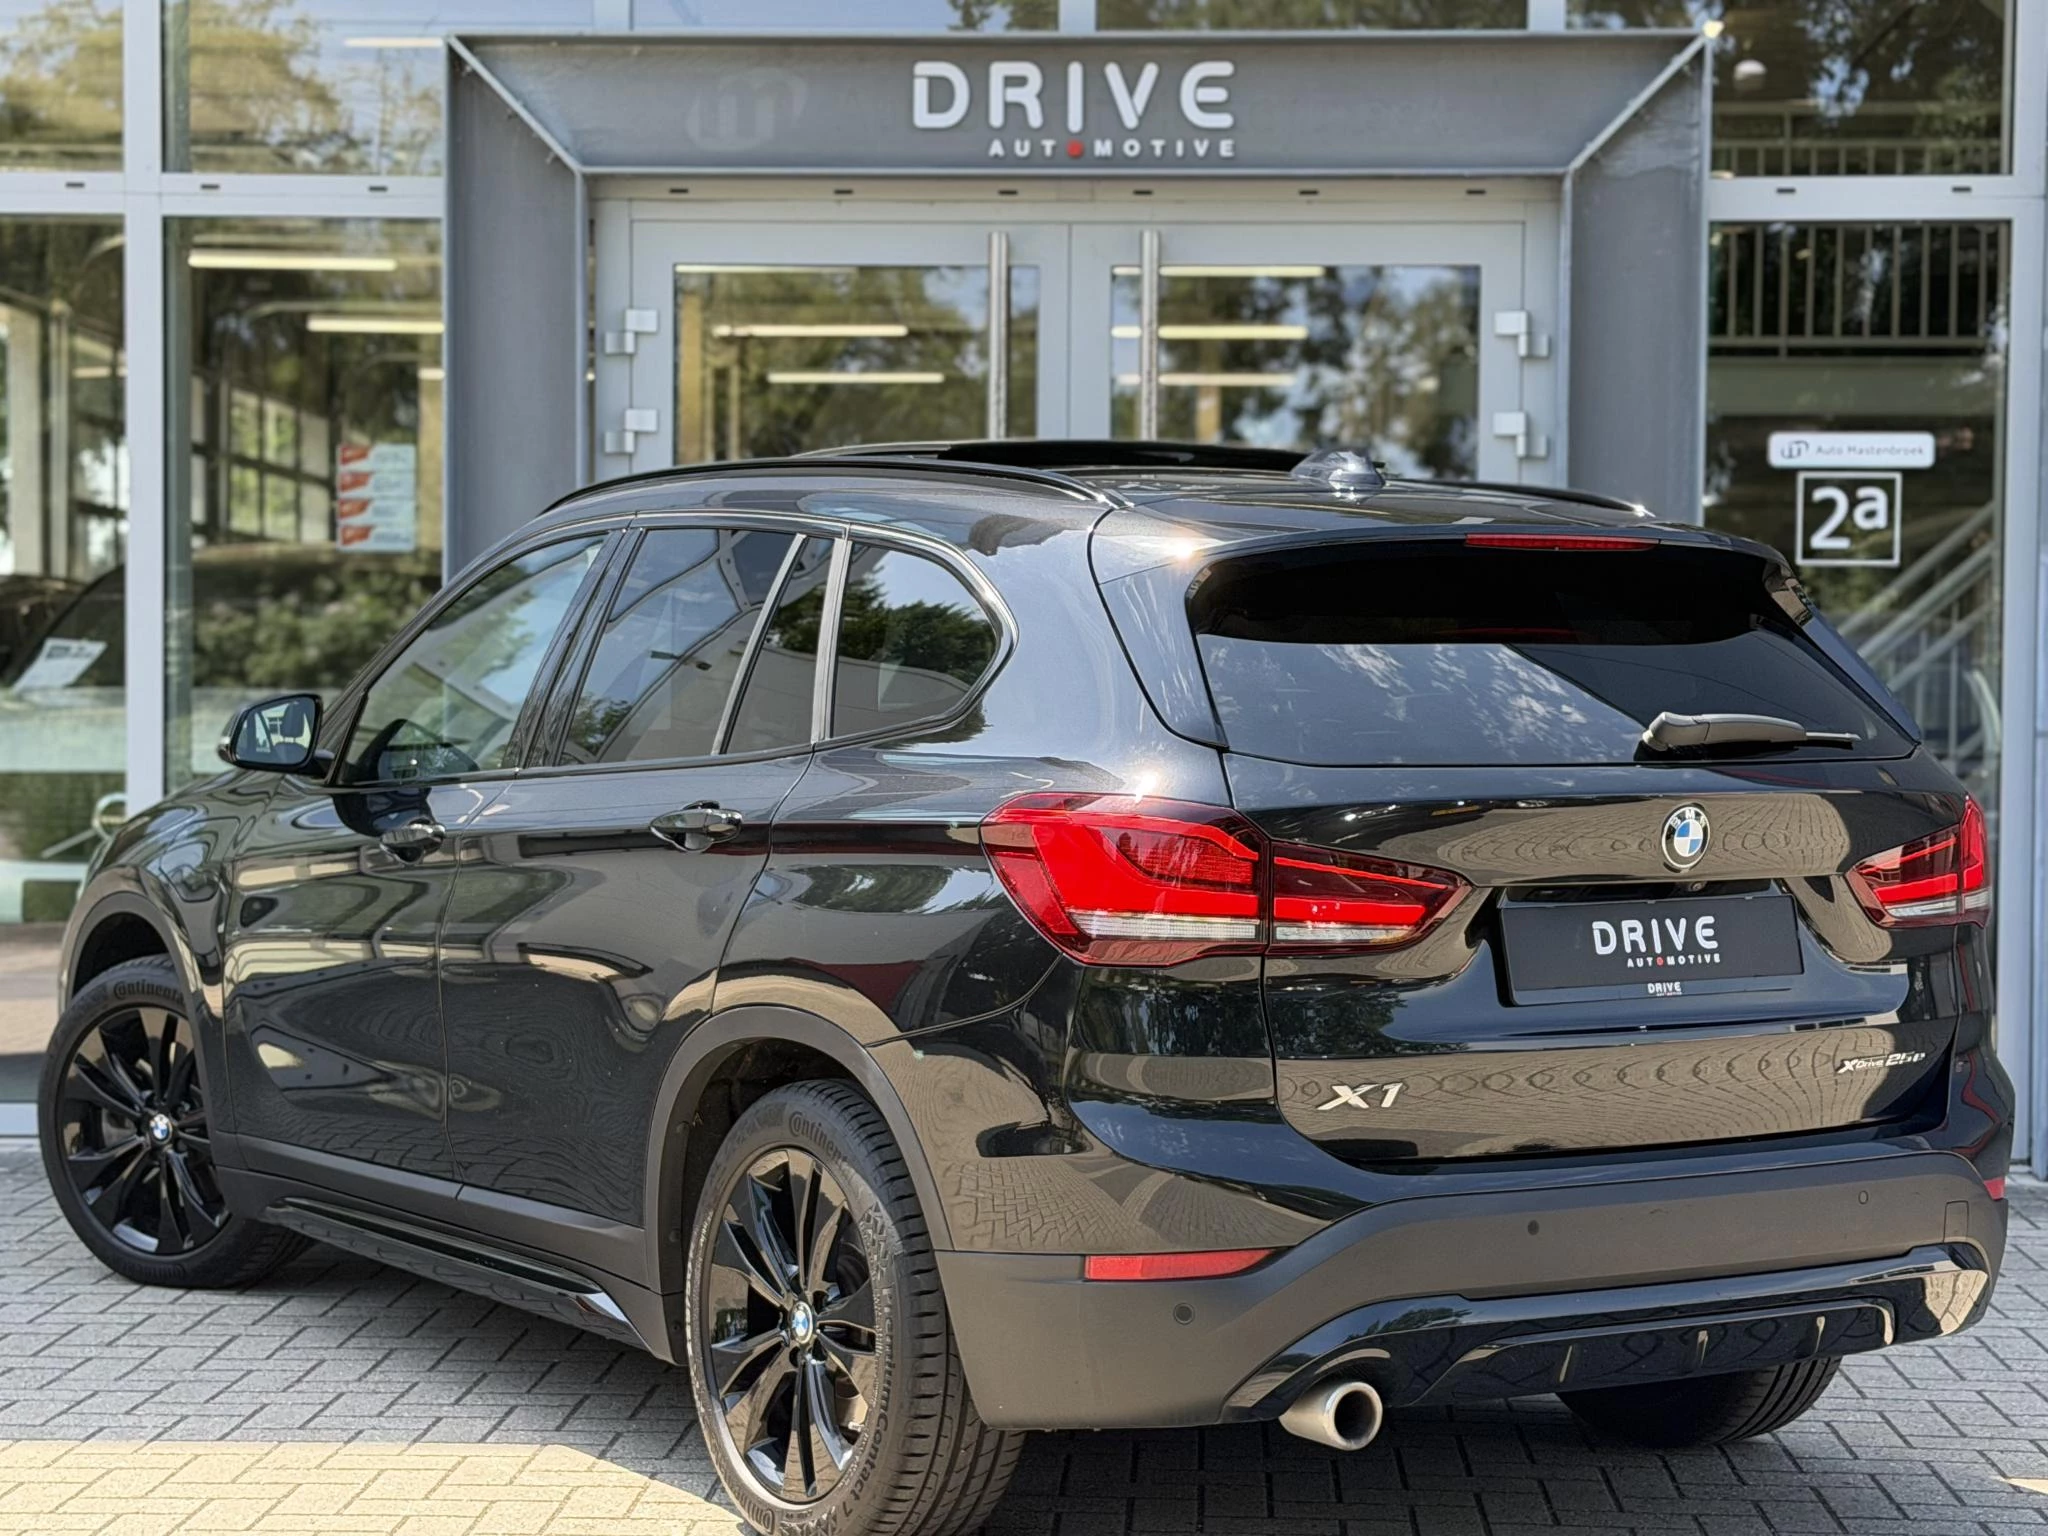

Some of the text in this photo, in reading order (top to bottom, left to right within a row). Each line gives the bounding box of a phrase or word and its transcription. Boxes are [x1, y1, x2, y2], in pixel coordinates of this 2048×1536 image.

[912, 60, 1235, 133] DRIVE
[988, 138, 1236, 158] AUTOMOTIVE
[1816, 444, 1924, 456] Auto Mastenbroek
[1810, 486, 1888, 549] 2a
[1592, 915, 1719, 955] DRIVE
[1627, 953, 1720, 968] AUTOMOTIVE
[1647, 981, 1682, 994] DRIVE
[1316, 1082, 1404, 1110] X1
